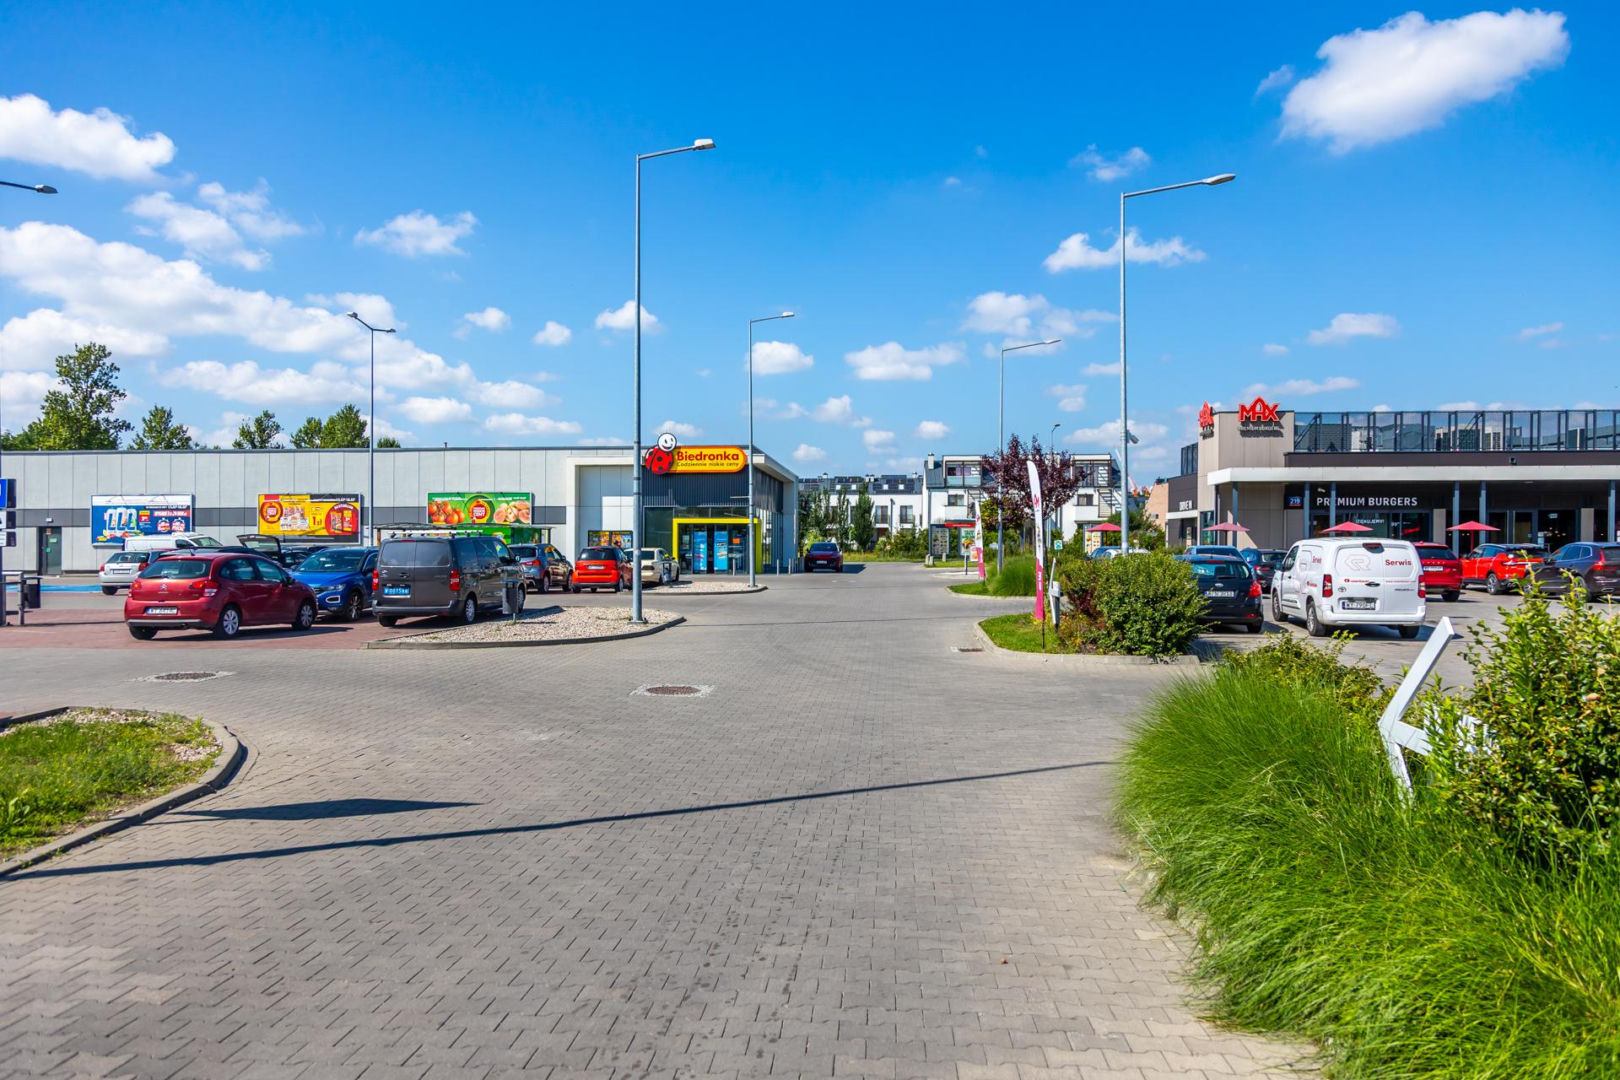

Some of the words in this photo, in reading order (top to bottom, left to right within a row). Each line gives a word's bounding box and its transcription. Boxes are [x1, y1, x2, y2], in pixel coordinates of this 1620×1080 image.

[1238, 396, 1280, 421] MAX
[676, 451, 739, 461] Biedronka
[1316, 497, 1365, 506] PRMIUM
[1368, 497, 1418, 506] BURGERS
